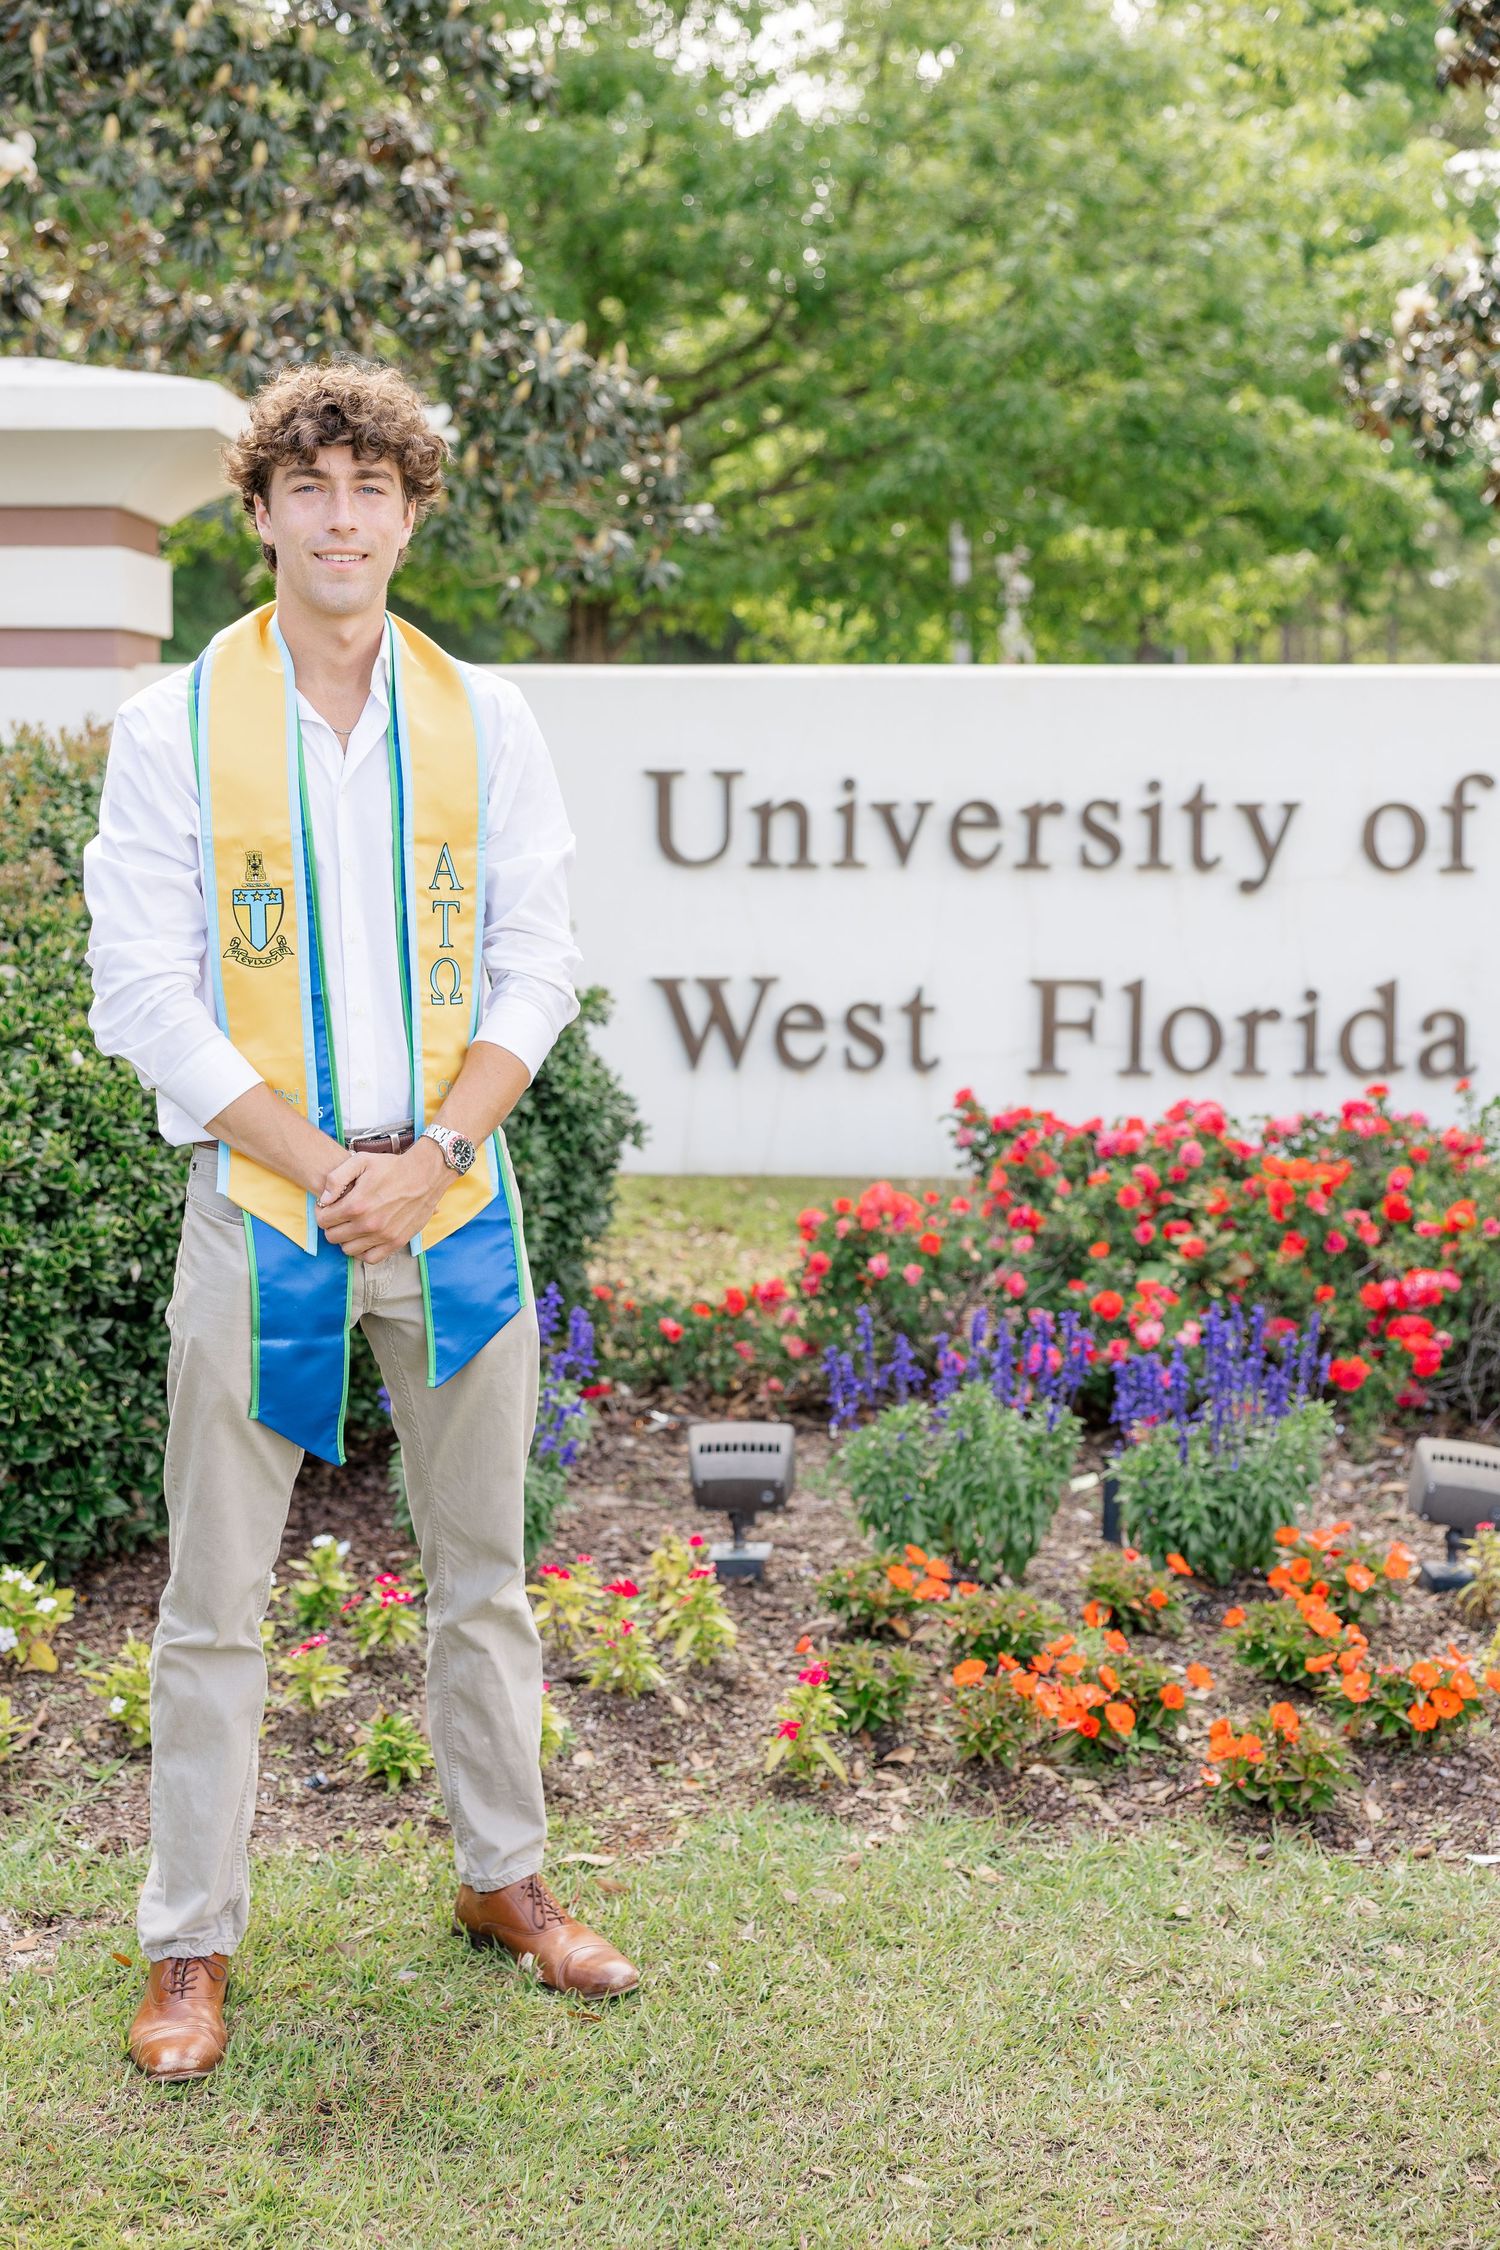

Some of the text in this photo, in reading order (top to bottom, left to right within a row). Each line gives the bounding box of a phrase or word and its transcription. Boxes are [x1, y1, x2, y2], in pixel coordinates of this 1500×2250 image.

[643, 770, 1495, 895] University of
[651, 977, 1477, 1078] West Florida
